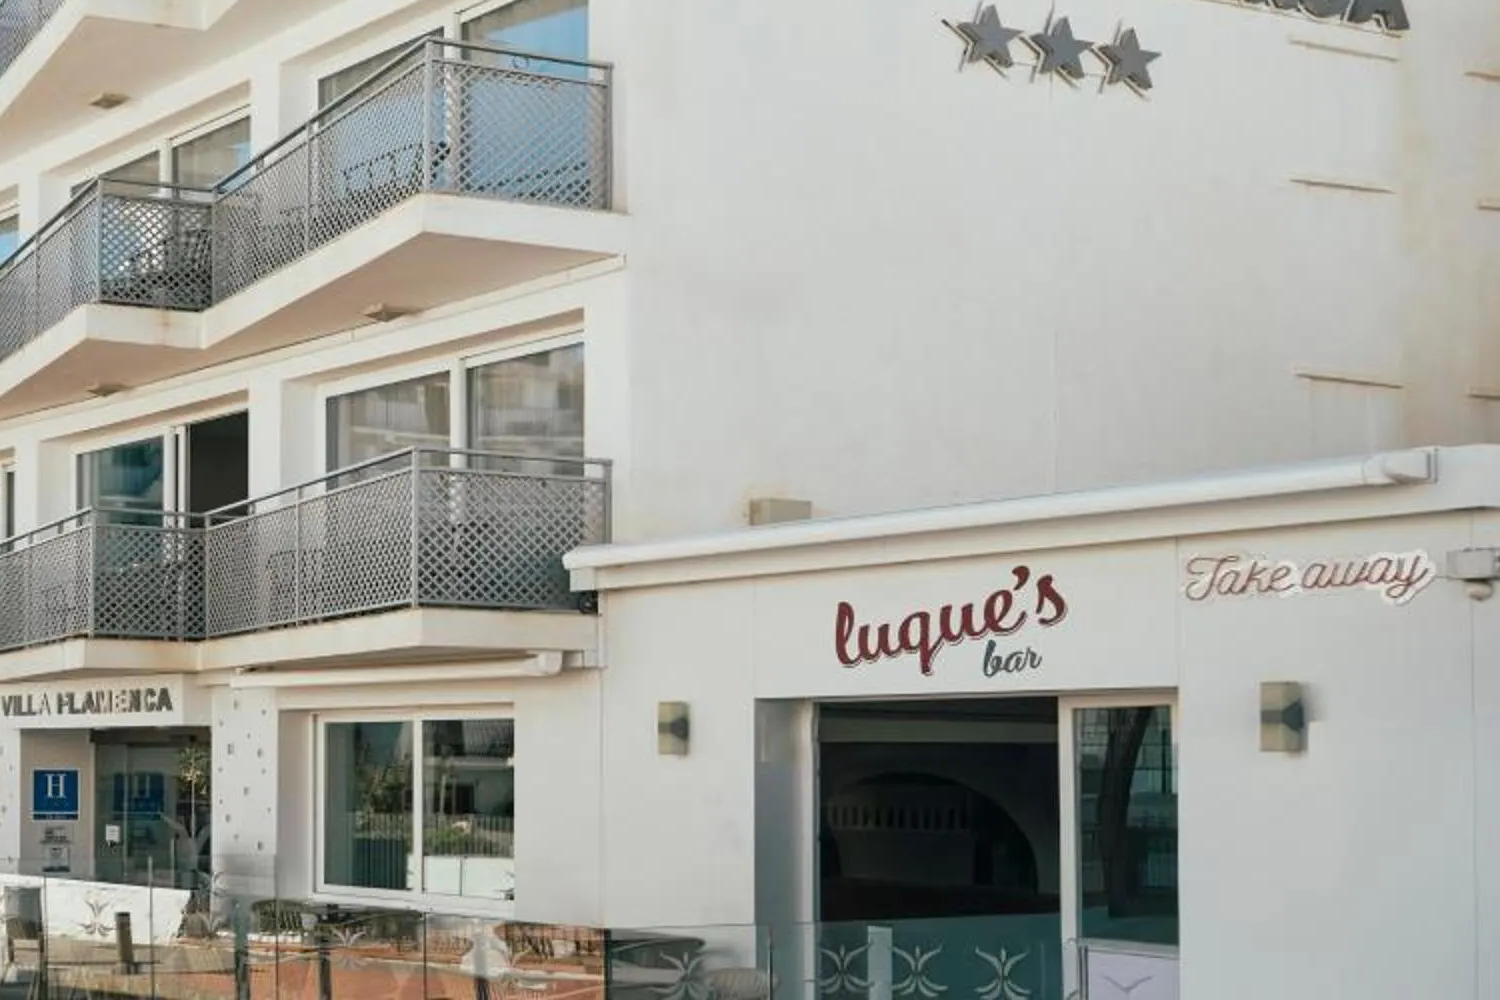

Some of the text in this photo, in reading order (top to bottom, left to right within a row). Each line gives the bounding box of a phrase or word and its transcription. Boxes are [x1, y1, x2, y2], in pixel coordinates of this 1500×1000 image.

[1185, 555, 1430, 601] Take away
[835, 565, 1069, 676] luque's
[983, 639, 1042, 678] bar
[1, 687, 174, 717] VILLA FLAMENCA
[44, 773, 68, 799] H
